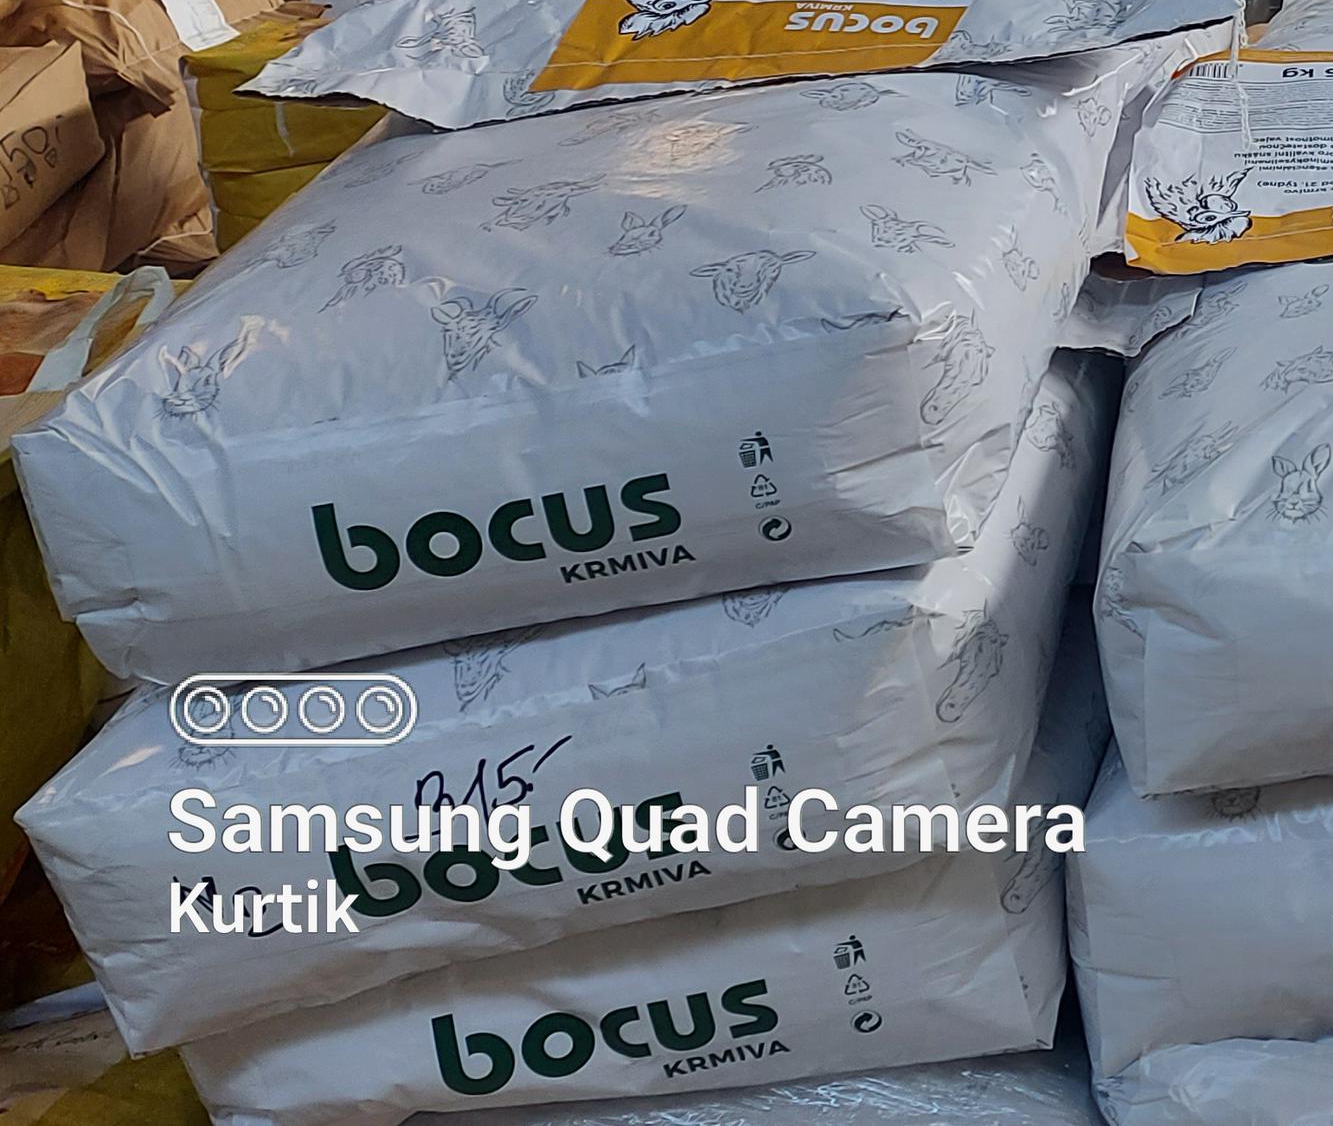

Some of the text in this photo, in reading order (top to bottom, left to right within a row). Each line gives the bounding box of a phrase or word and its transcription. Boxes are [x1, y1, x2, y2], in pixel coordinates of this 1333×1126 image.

[784, 11, 938, 38] bocus
[795, 3, 853, 11] KRMIVA
[1281, 67, 1314, 79] kg
[311, 473, 681, 591] bocus
[559, 543, 695, 584] KRMIVA
[577, 858, 711, 904] KRMIVA
[432, 978, 779, 1094] bocus
[663, 1039, 790, 1078] KRMIVA
